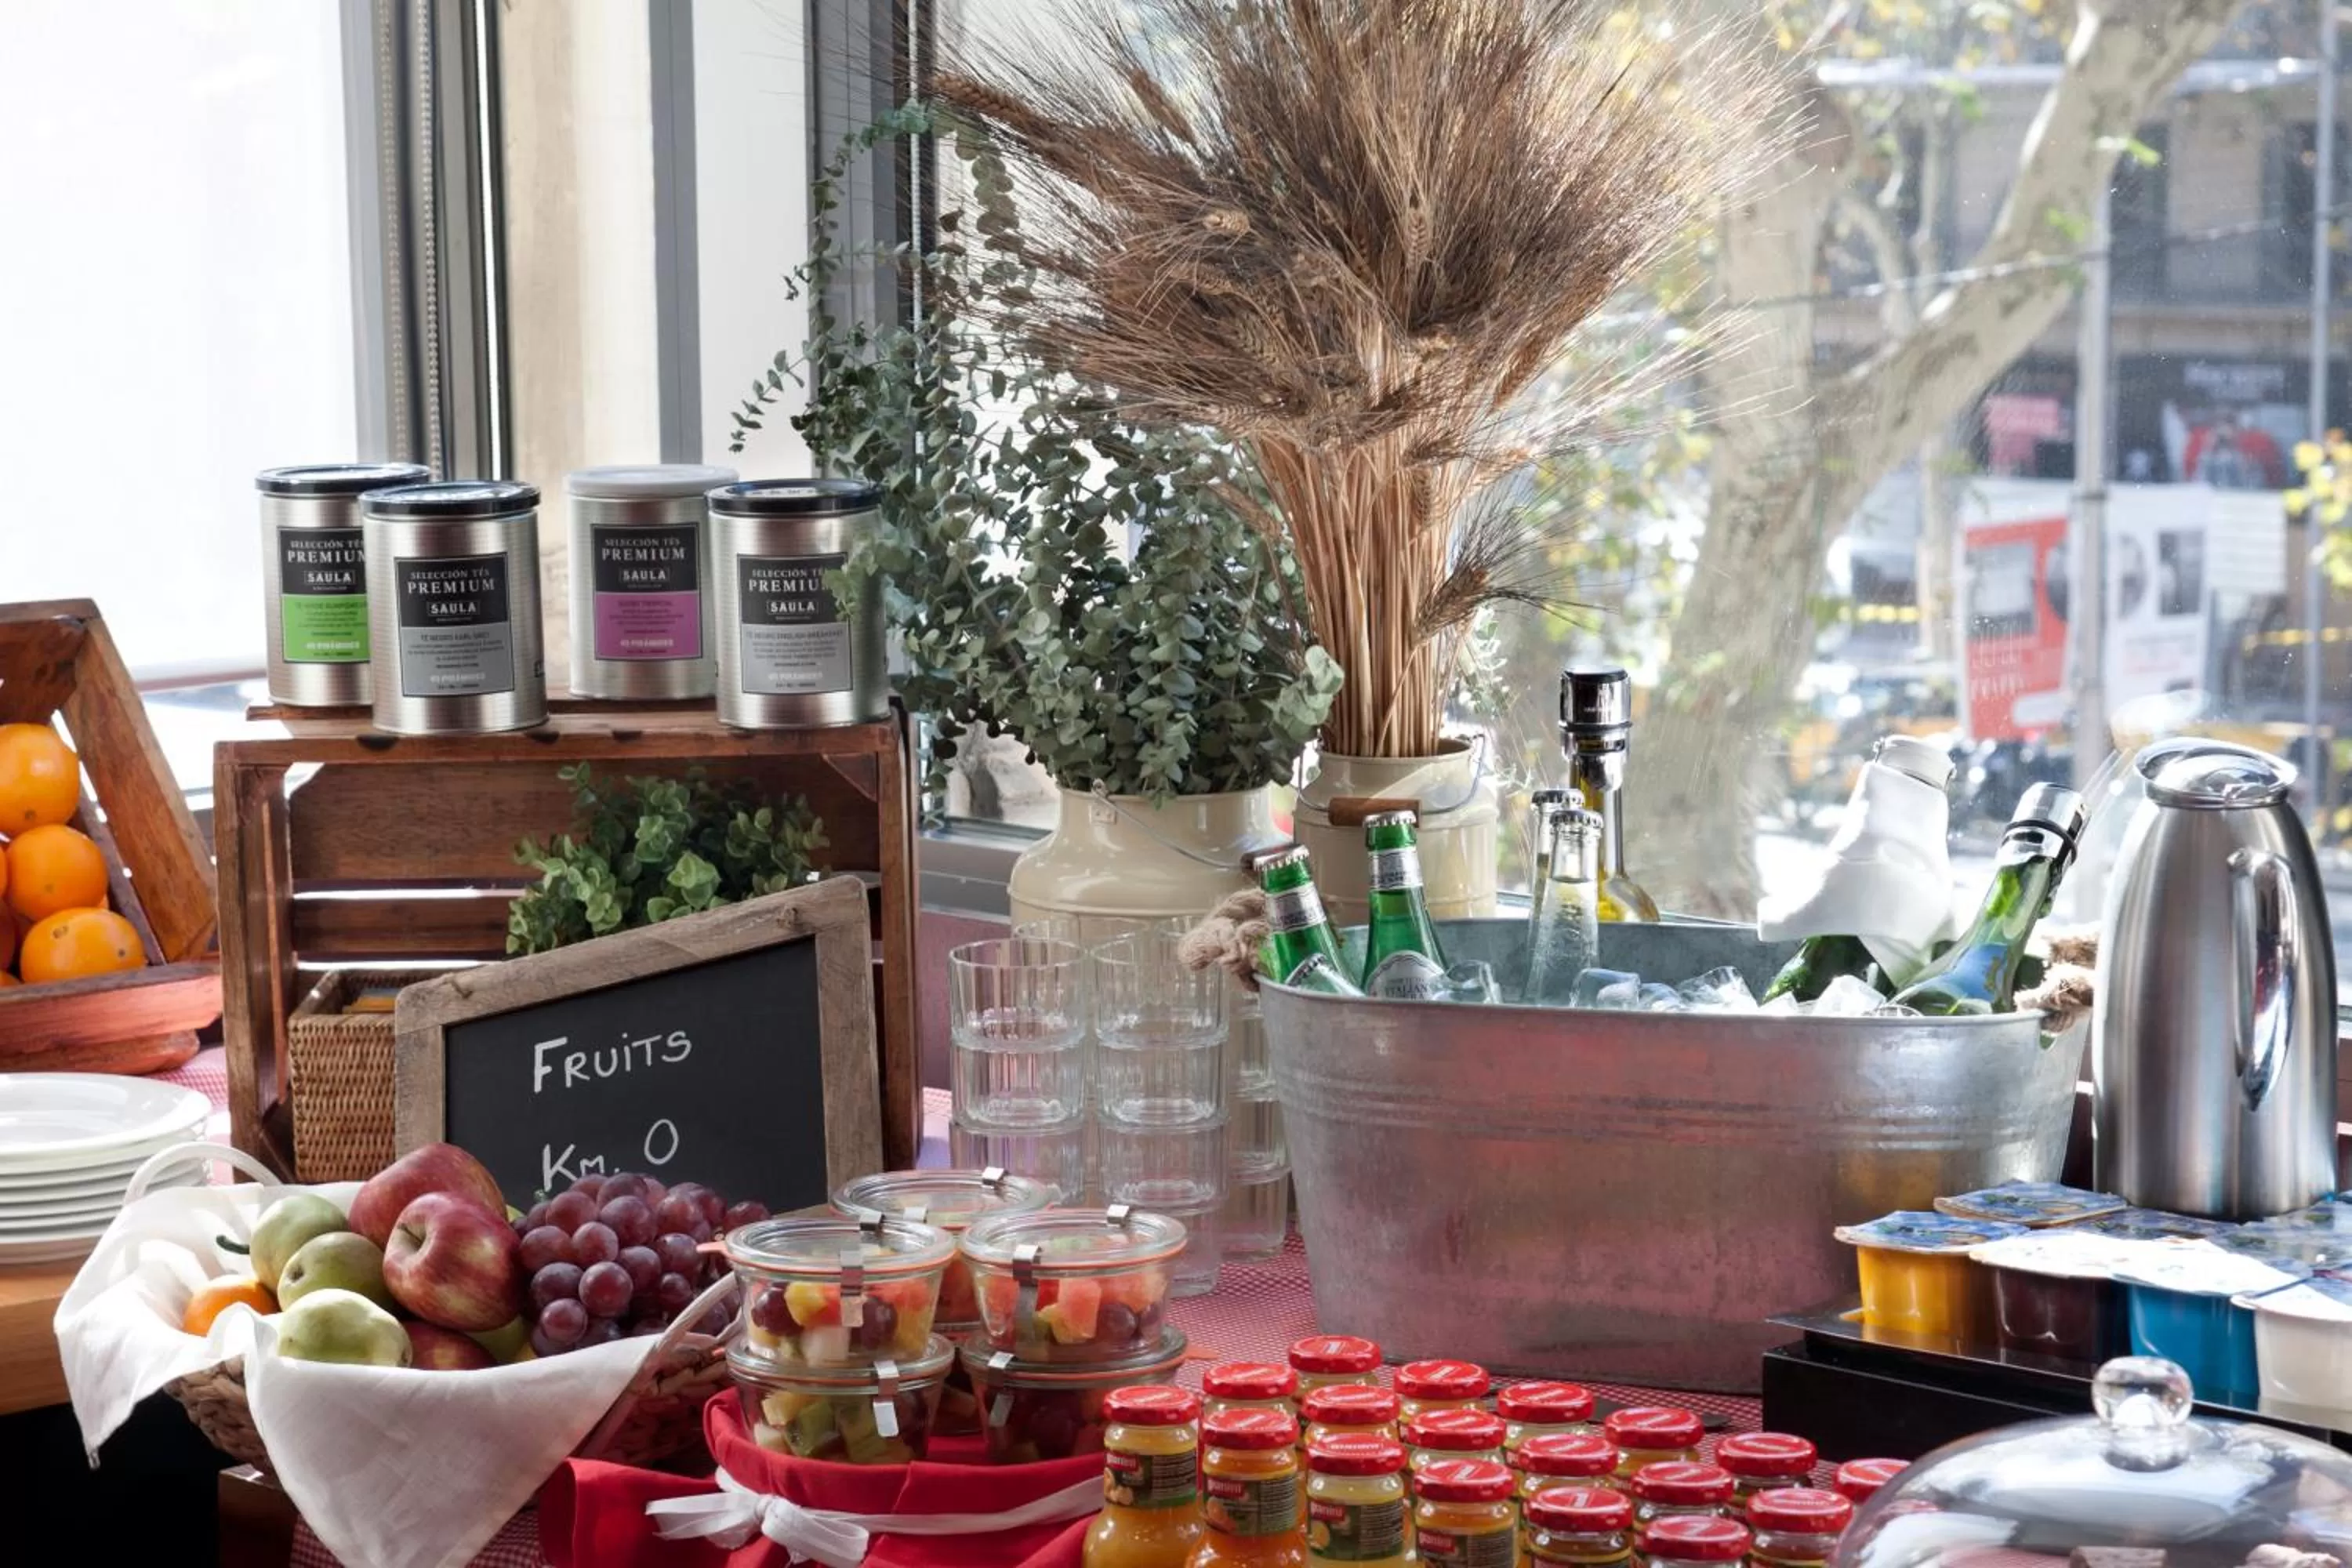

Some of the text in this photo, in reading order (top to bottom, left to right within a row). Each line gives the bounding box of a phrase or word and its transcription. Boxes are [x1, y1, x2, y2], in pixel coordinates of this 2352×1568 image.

[290, 539, 343, 549] SELECCIÓN
[605, 536, 681, 547] SELECCIÓN TÉS
[601, 547, 684, 561] PREMIUM
[307, 572, 352, 583] SAULA
[410, 567, 490, 580] SELECCIÓN TÉS
[622, 570, 666, 581] SAULA
[752, 568, 808, 578] SELECCIÓN
[407, 578, 495, 594] PREMIUM
[749, 579, 826, 593] PREMIU
[431, 601, 477, 614] SAULA
[771, 601, 815, 613] SAULA
